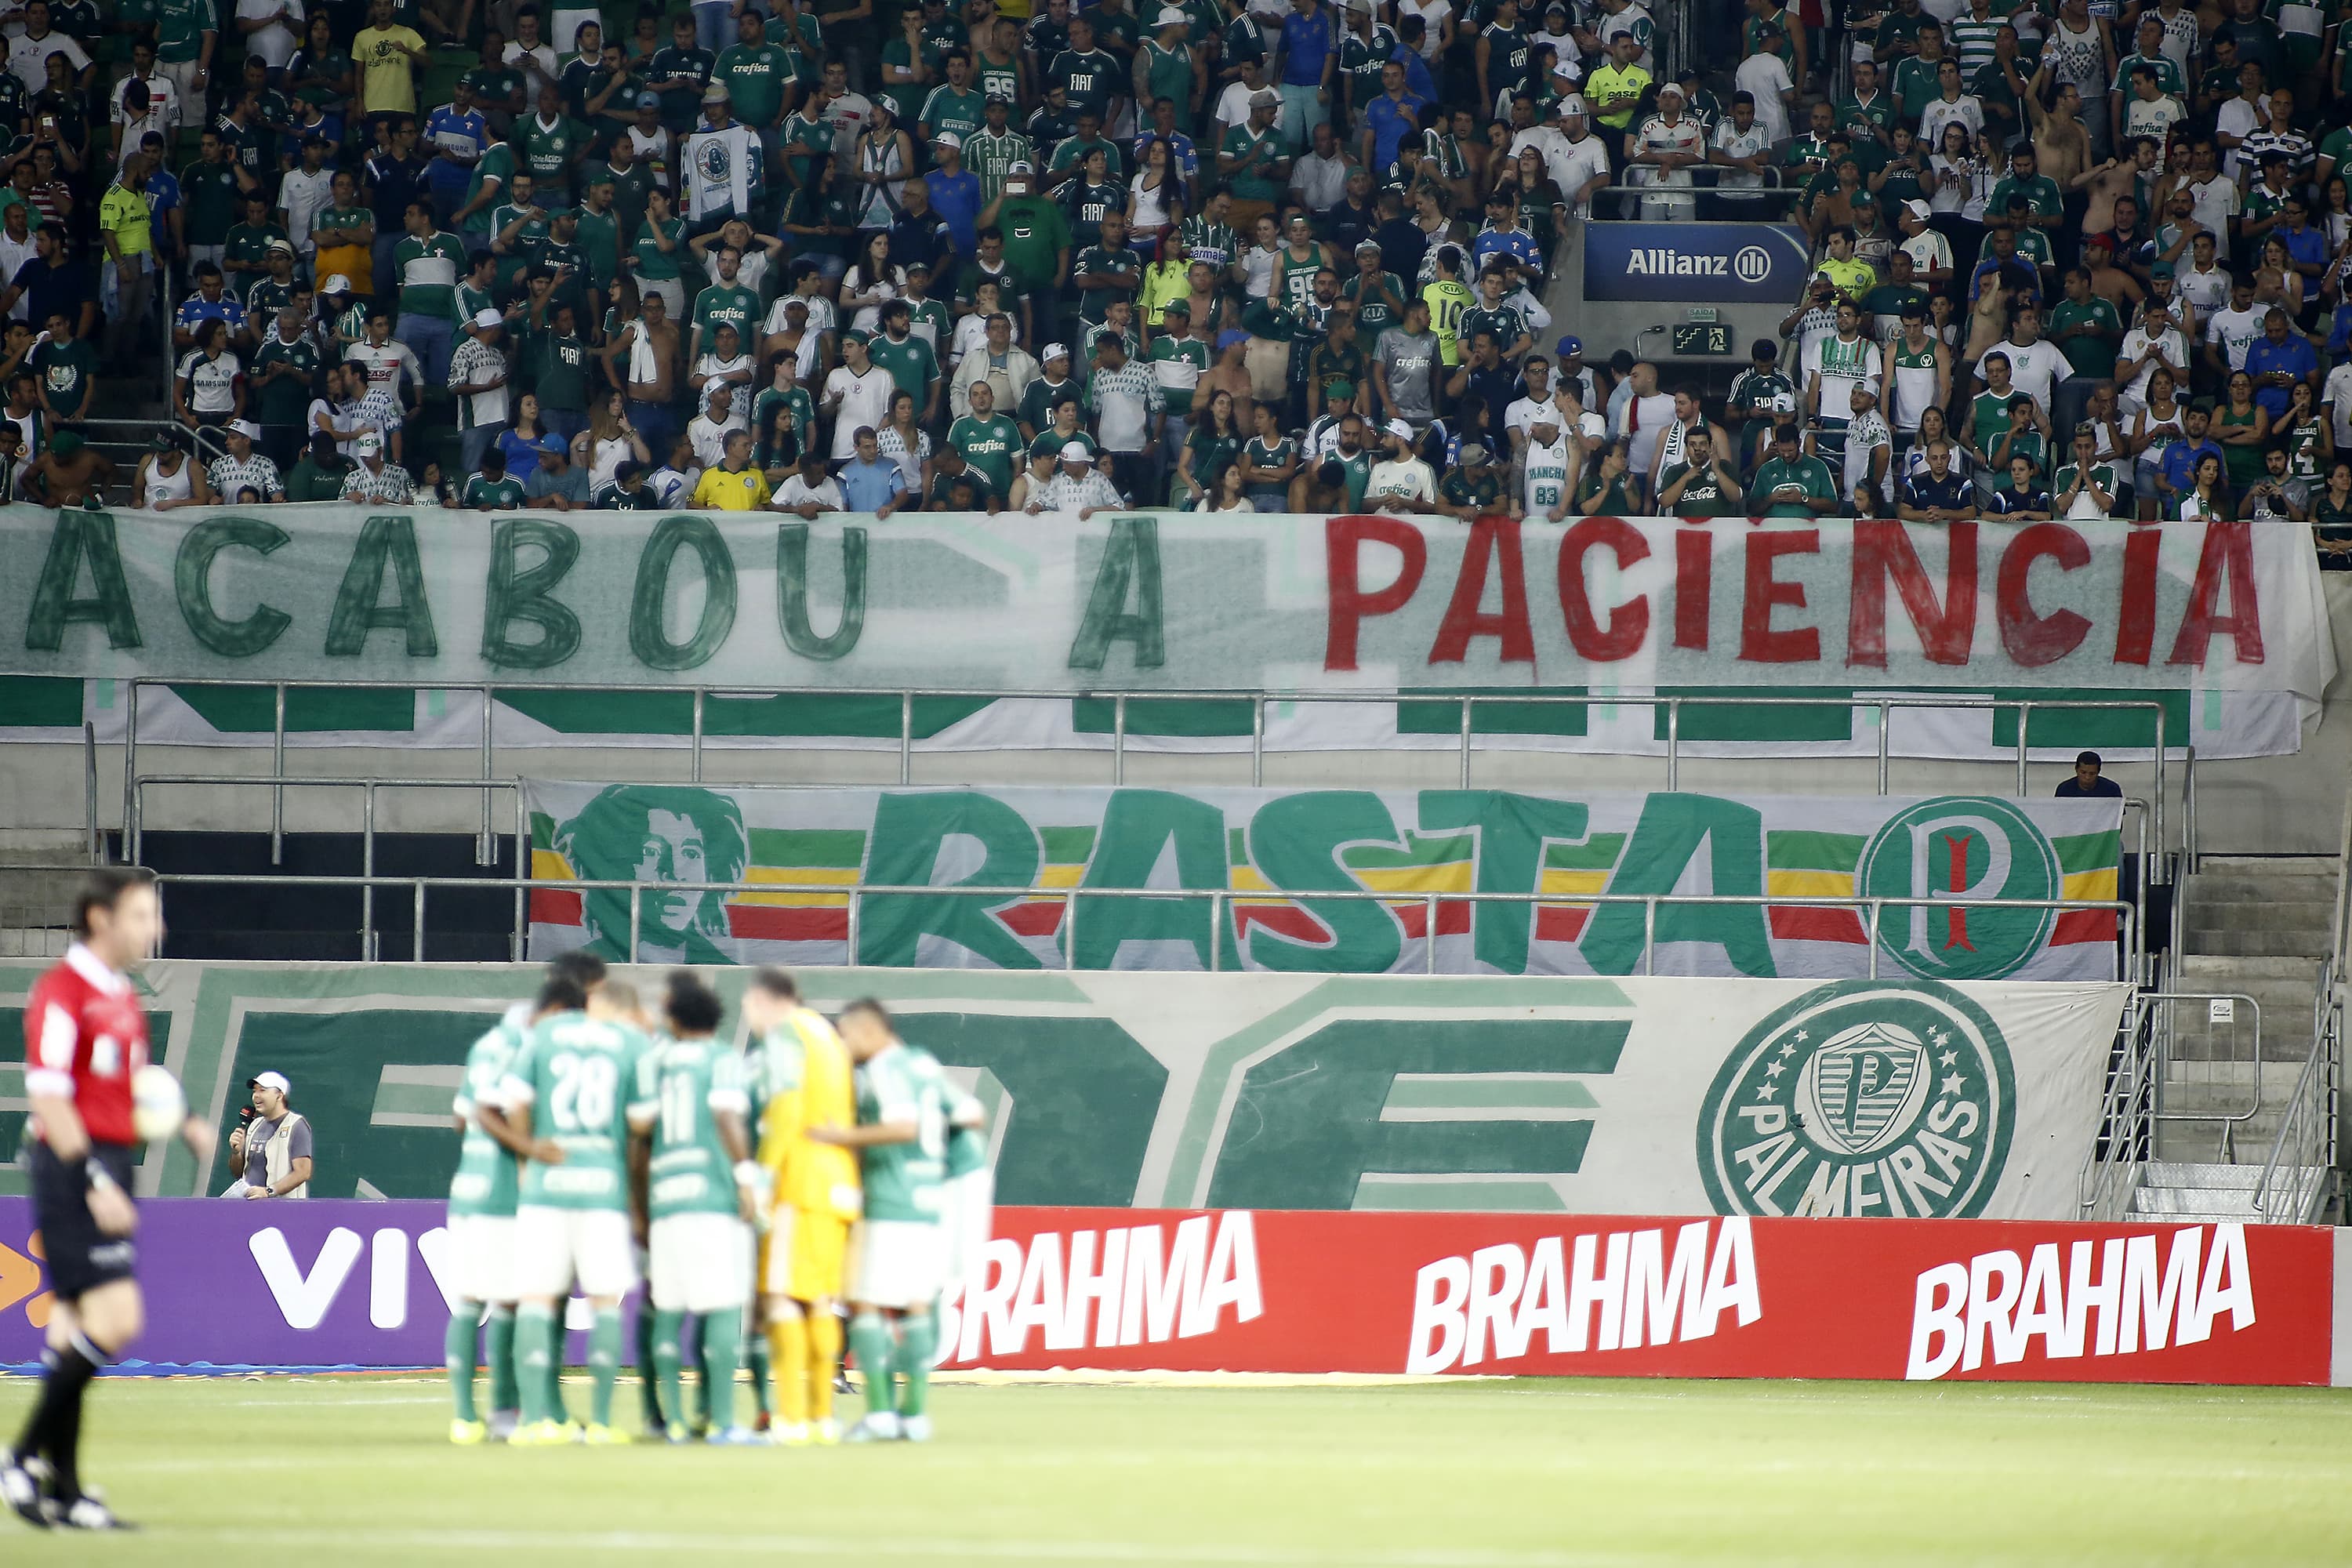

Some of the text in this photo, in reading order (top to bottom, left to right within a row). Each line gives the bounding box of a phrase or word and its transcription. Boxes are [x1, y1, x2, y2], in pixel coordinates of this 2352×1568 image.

[931, 37, 954, 49] fisa
[1509, 47, 1528, 68] FIAT
[732, 63, 770, 75] crefisa
[1070, 73, 1094, 92] FIAT
[986, 158, 1010, 175] FIAT
[1944, 174, 1960, 191] FIA
[1082, 203, 1106, 222] FIAT
[1626, 249, 1727, 275] Allianz
[1443, 284, 1460, 293] KIA
[710, 307, 746, 321] crefisa
[1362, 307, 1386, 318] KIA
[1439, 299, 1464, 330] 10
[561, 345, 581, 366] FIAT
[967, 439, 1006, 454] crefisa
[1536, 486, 1558, 506] 83
[24, 509, 868, 671] ACABOU
[1069, 517, 1165, 670] A
[858, 788, 1777, 978] RASTA
[549, 1053, 618, 1131] 28
[660, 1072, 696, 1148] 11
[1735, 1100, 1980, 1218] PALMEIRAS
[1406, 1216, 1762, 1375] BRAHMA
[1905, 1222, 2256, 1381] BRAHMA
